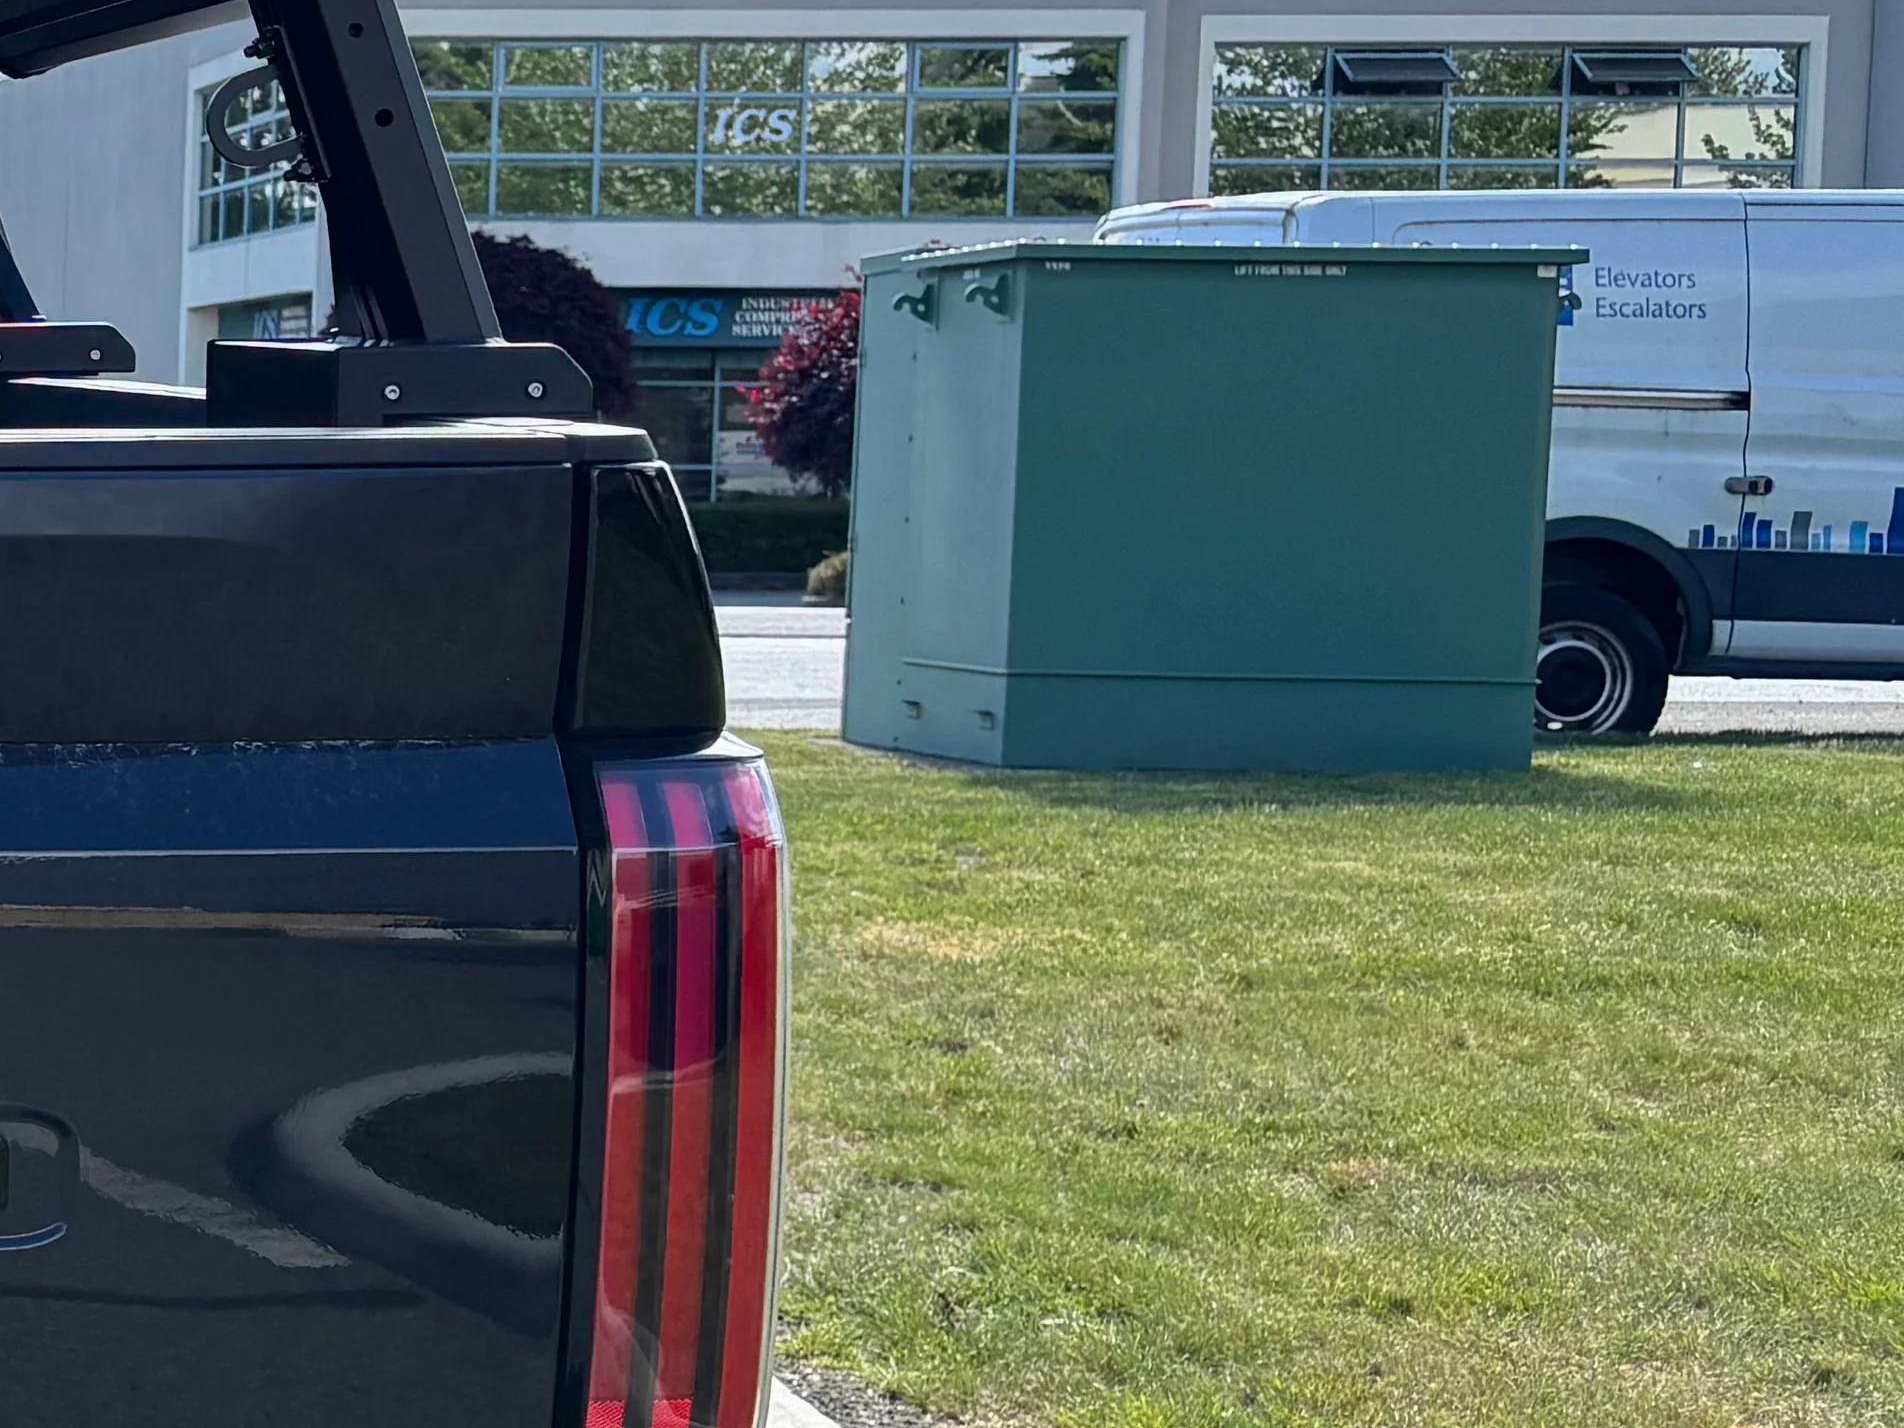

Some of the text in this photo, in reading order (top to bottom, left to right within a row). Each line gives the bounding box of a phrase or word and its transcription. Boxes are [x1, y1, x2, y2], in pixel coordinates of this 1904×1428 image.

[712, 108, 798, 145] ICS
[1594, 266, 1697, 290] Elevators
[625, 297, 724, 337] ICS
[1595, 296, 1708, 320] Escalators
